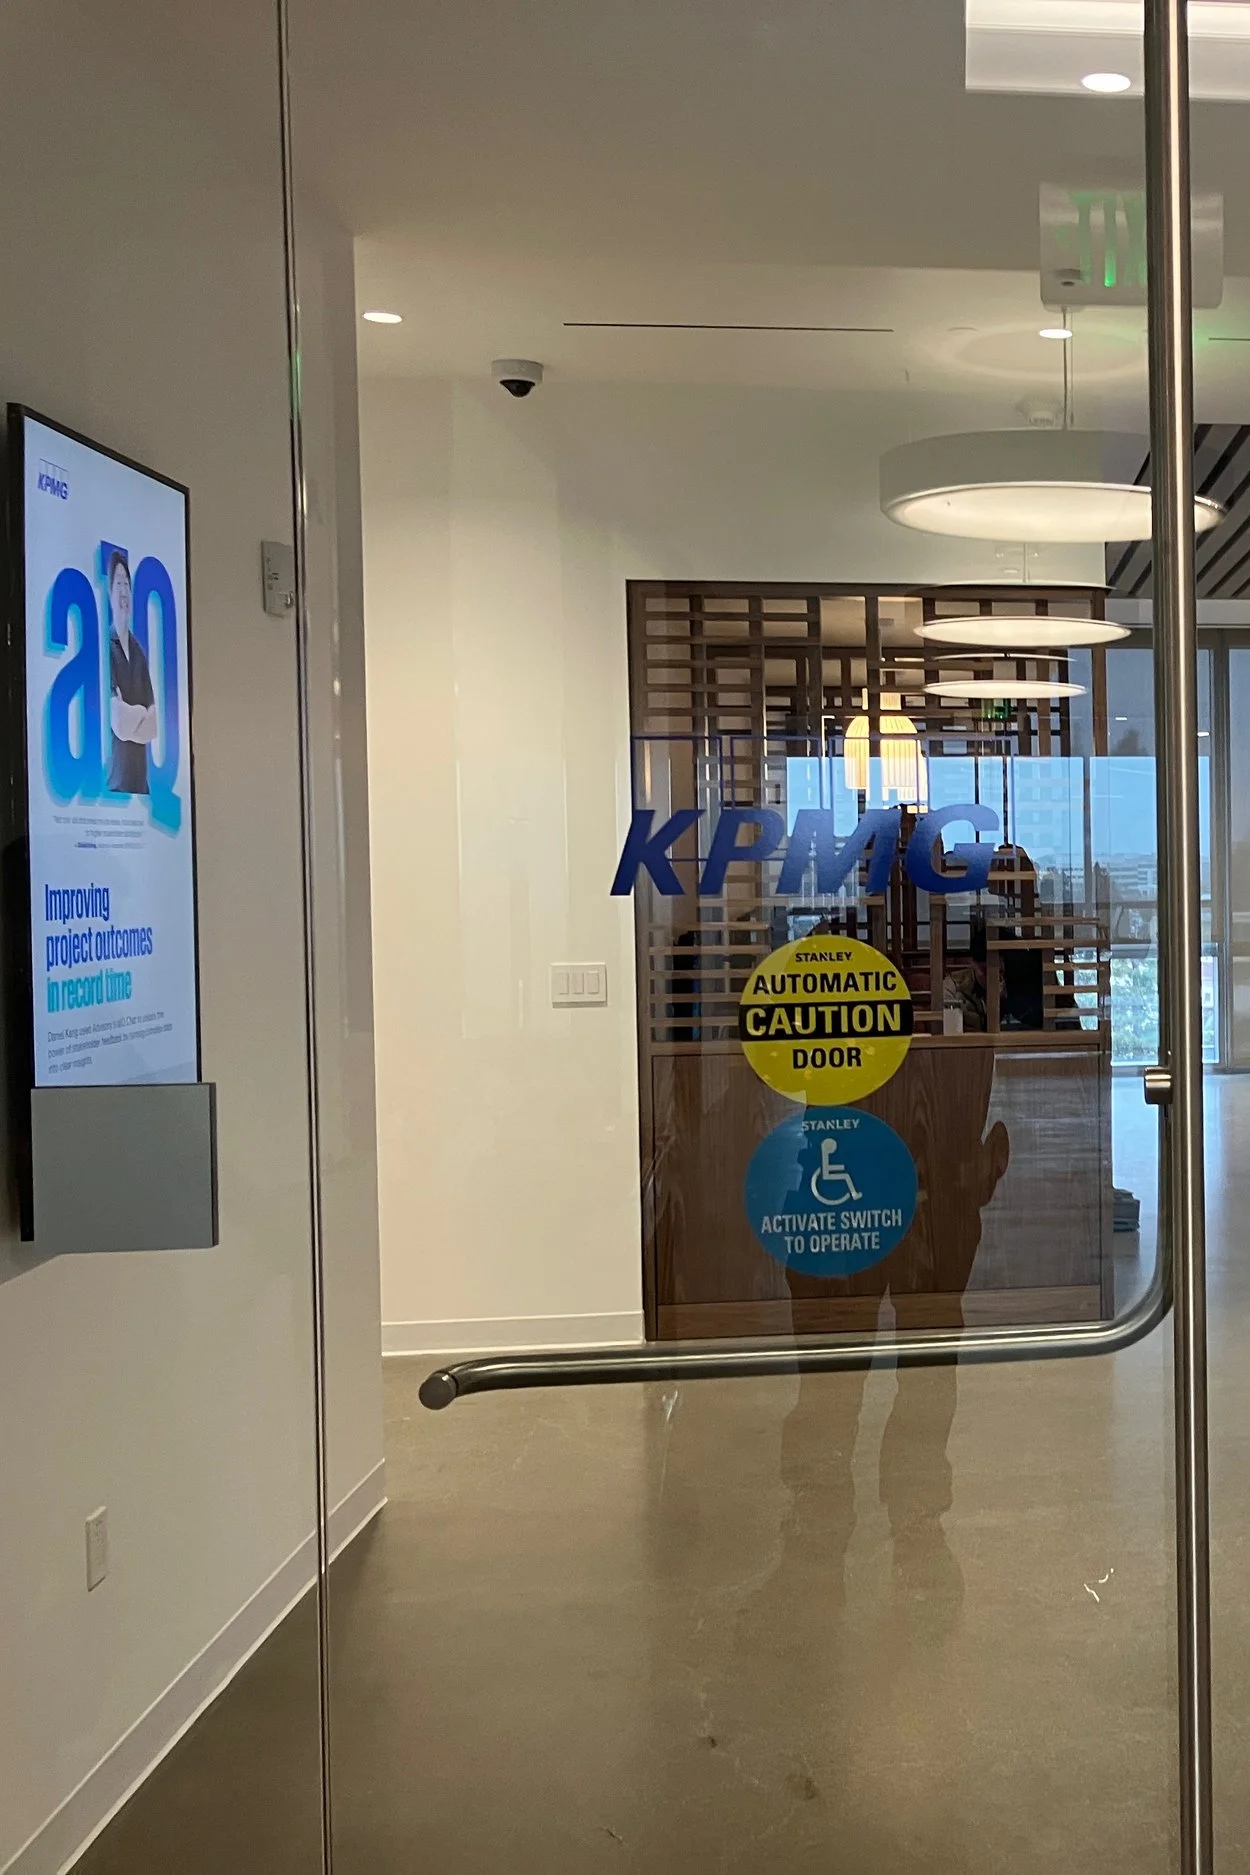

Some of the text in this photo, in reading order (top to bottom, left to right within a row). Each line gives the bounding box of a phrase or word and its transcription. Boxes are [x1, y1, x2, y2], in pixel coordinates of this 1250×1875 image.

[38, 472, 68, 501] KPMG
[610, 804, 1000, 896] KPMG
[45, 883, 110, 925] Improving
[46, 925, 153, 972] project outcomes
[795, 951, 853, 963] STANLEY
[47, 968, 132, 1013] in record time
[753, 970, 897, 995] AUTOMATIC
[746, 1003, 900, 1036] CAUTION
[792, 1047, 862, 1070] DOOR
[801, 1118, 860, 1131] STANLEY
[761, 1209, 902, 1233] ACTIVATE SWITCH
[784, 1232, 880, 1254] TO OPERATE
